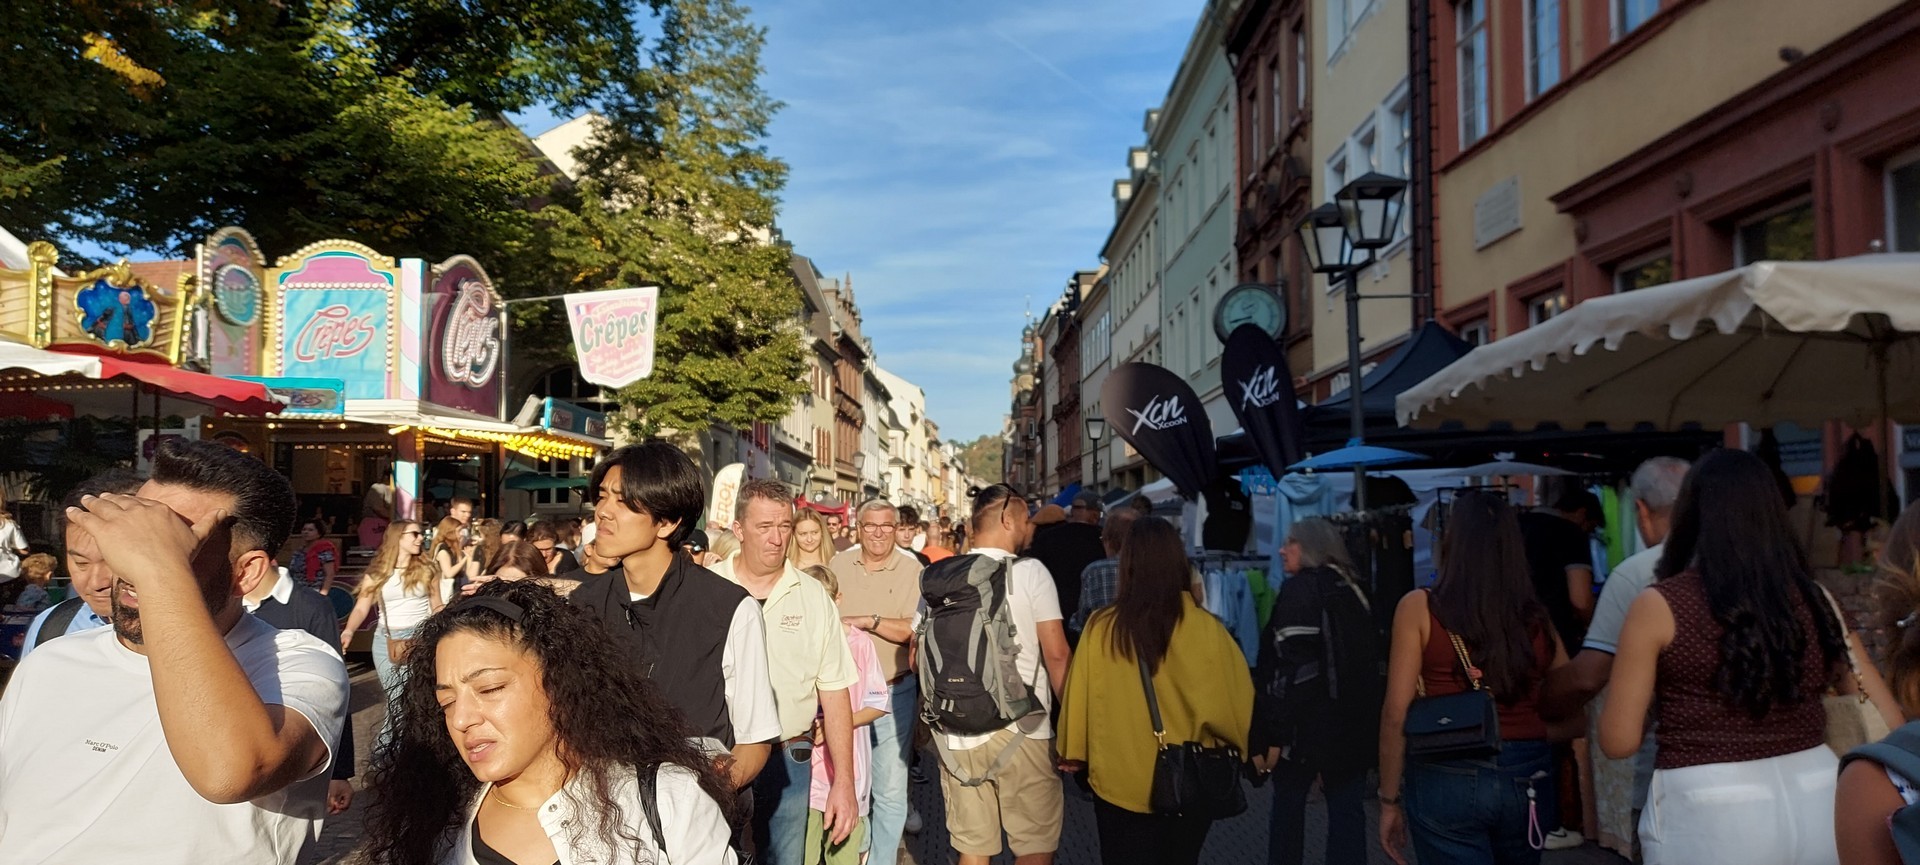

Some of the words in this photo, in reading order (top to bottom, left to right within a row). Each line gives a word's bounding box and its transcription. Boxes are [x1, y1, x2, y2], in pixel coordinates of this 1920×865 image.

[294, 304, 375, 361] Crêpes
[445, 281, 500, 385] Crêpes
[578, 310, 648, 353] Crêpes
